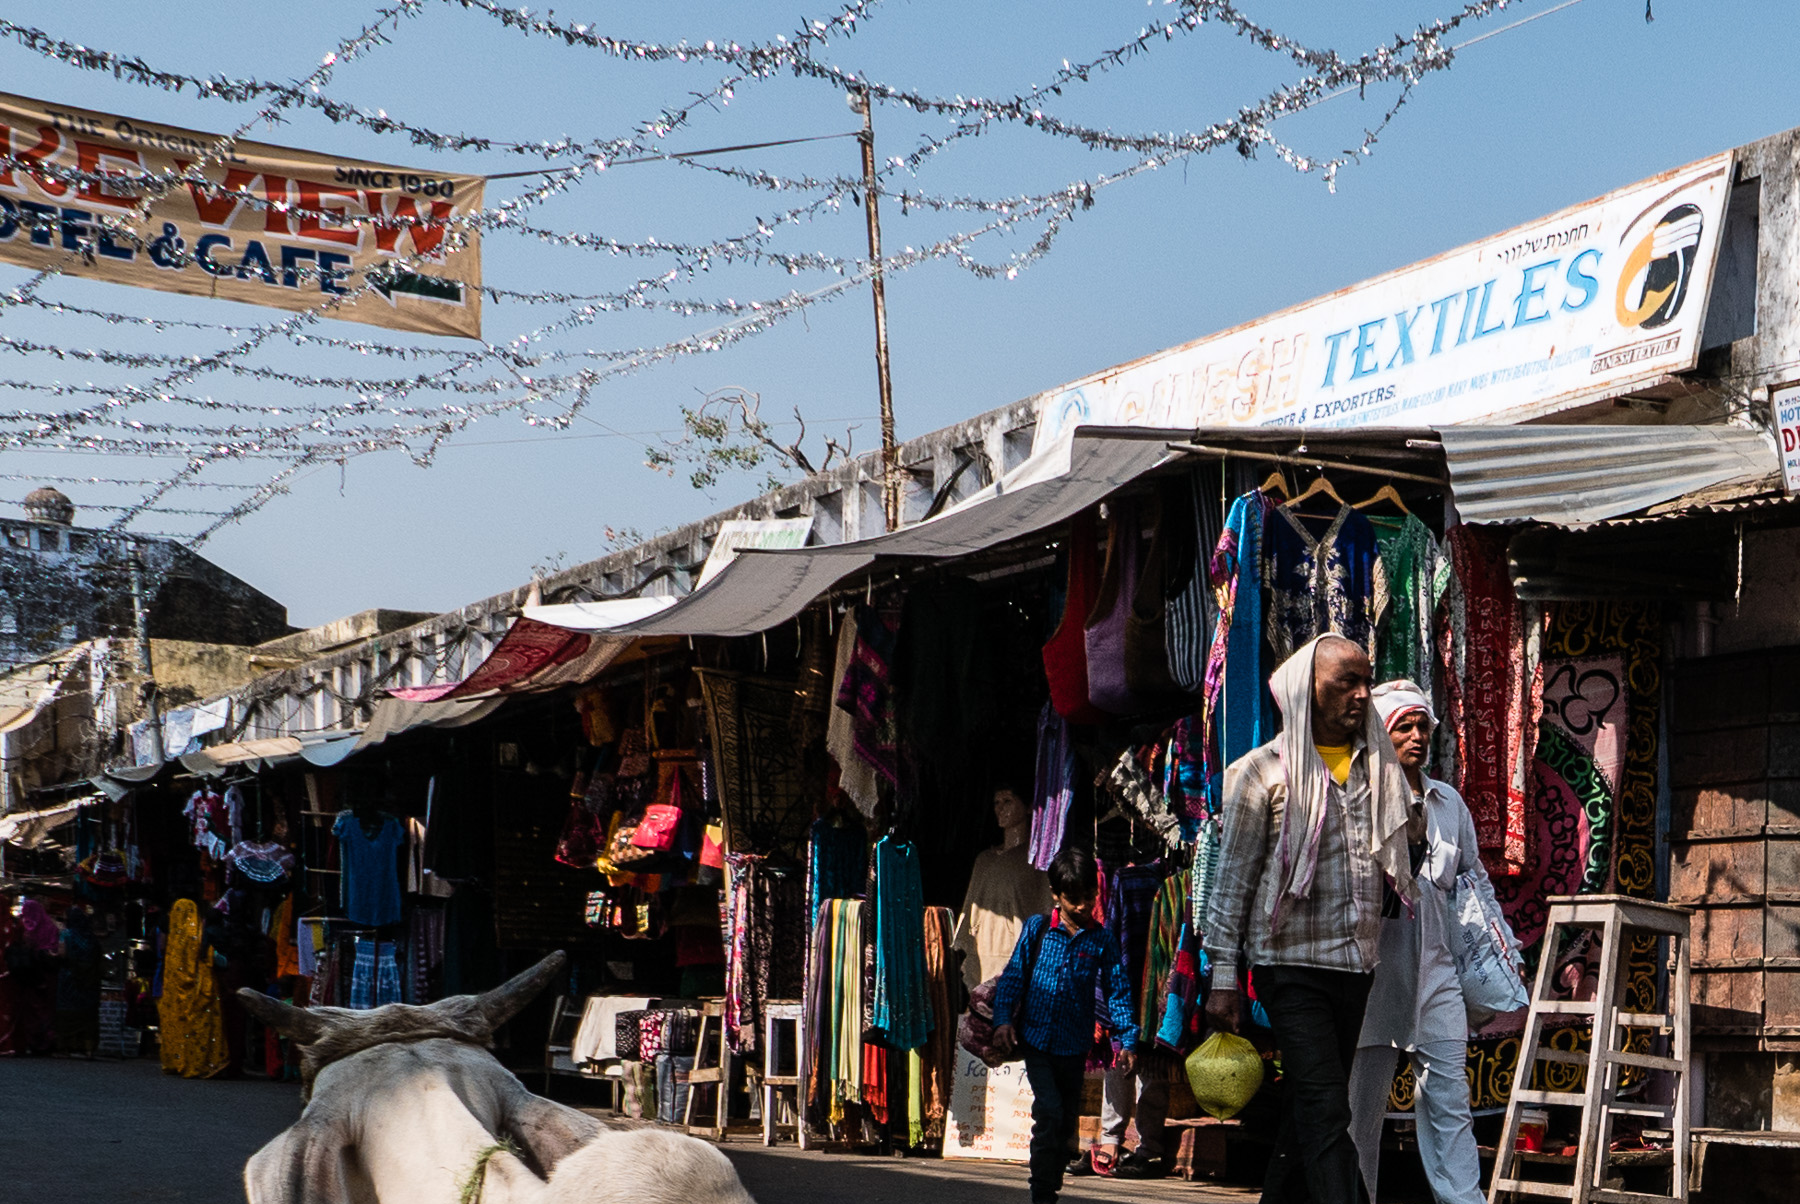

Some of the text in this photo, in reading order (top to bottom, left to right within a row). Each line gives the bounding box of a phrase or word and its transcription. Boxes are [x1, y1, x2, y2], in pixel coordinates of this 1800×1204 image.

[44, 108, 105, 139] THE
[334, 166, 454, 198] SINCE 1980
[1320, 248, 1605, 390] TEXTILES
[1313, 384, 1396, 419] EXPORTERS.
